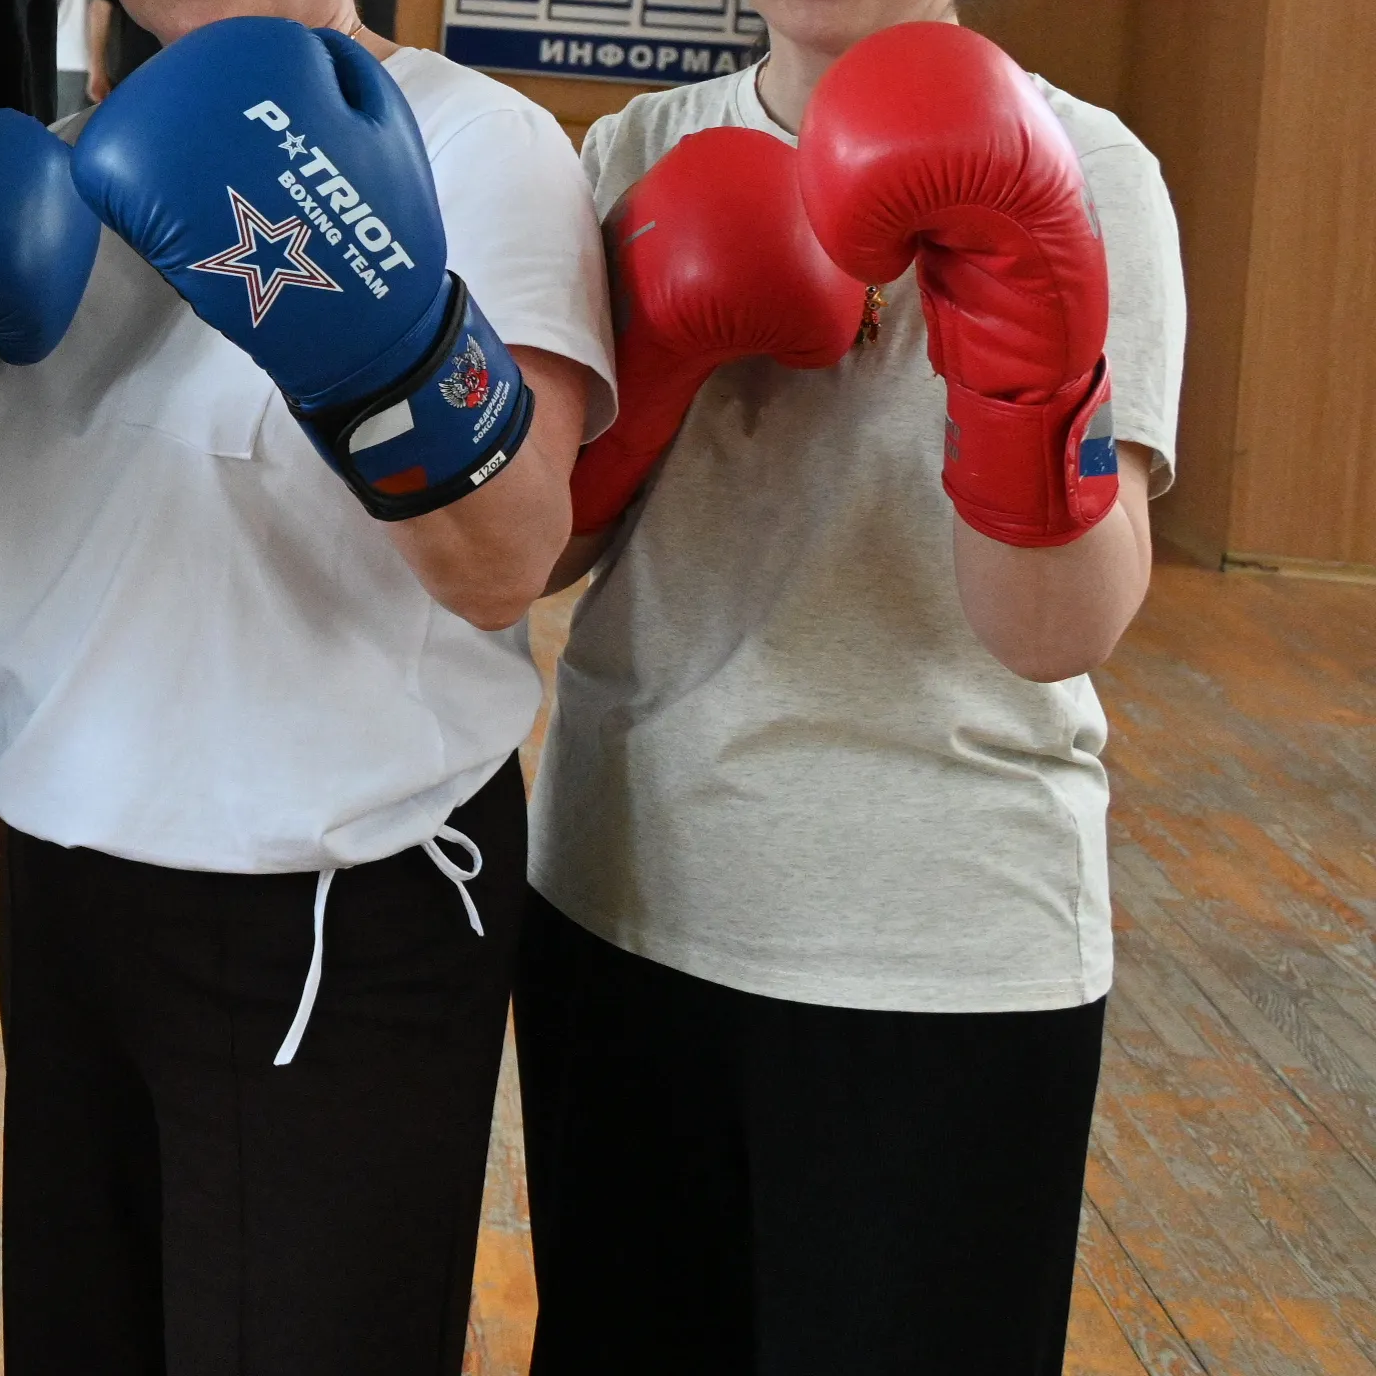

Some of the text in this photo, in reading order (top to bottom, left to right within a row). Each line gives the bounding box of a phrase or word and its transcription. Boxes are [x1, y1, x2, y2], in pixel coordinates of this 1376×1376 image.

[276, 169, 389, 301] BOXING TEAM
[472, 380, 511, 445] БОКСА РОССИИ
[473, 379, 505, 432] ФЕДЕРАЦИЯ
[478, 455, 504, 480] 12oz
